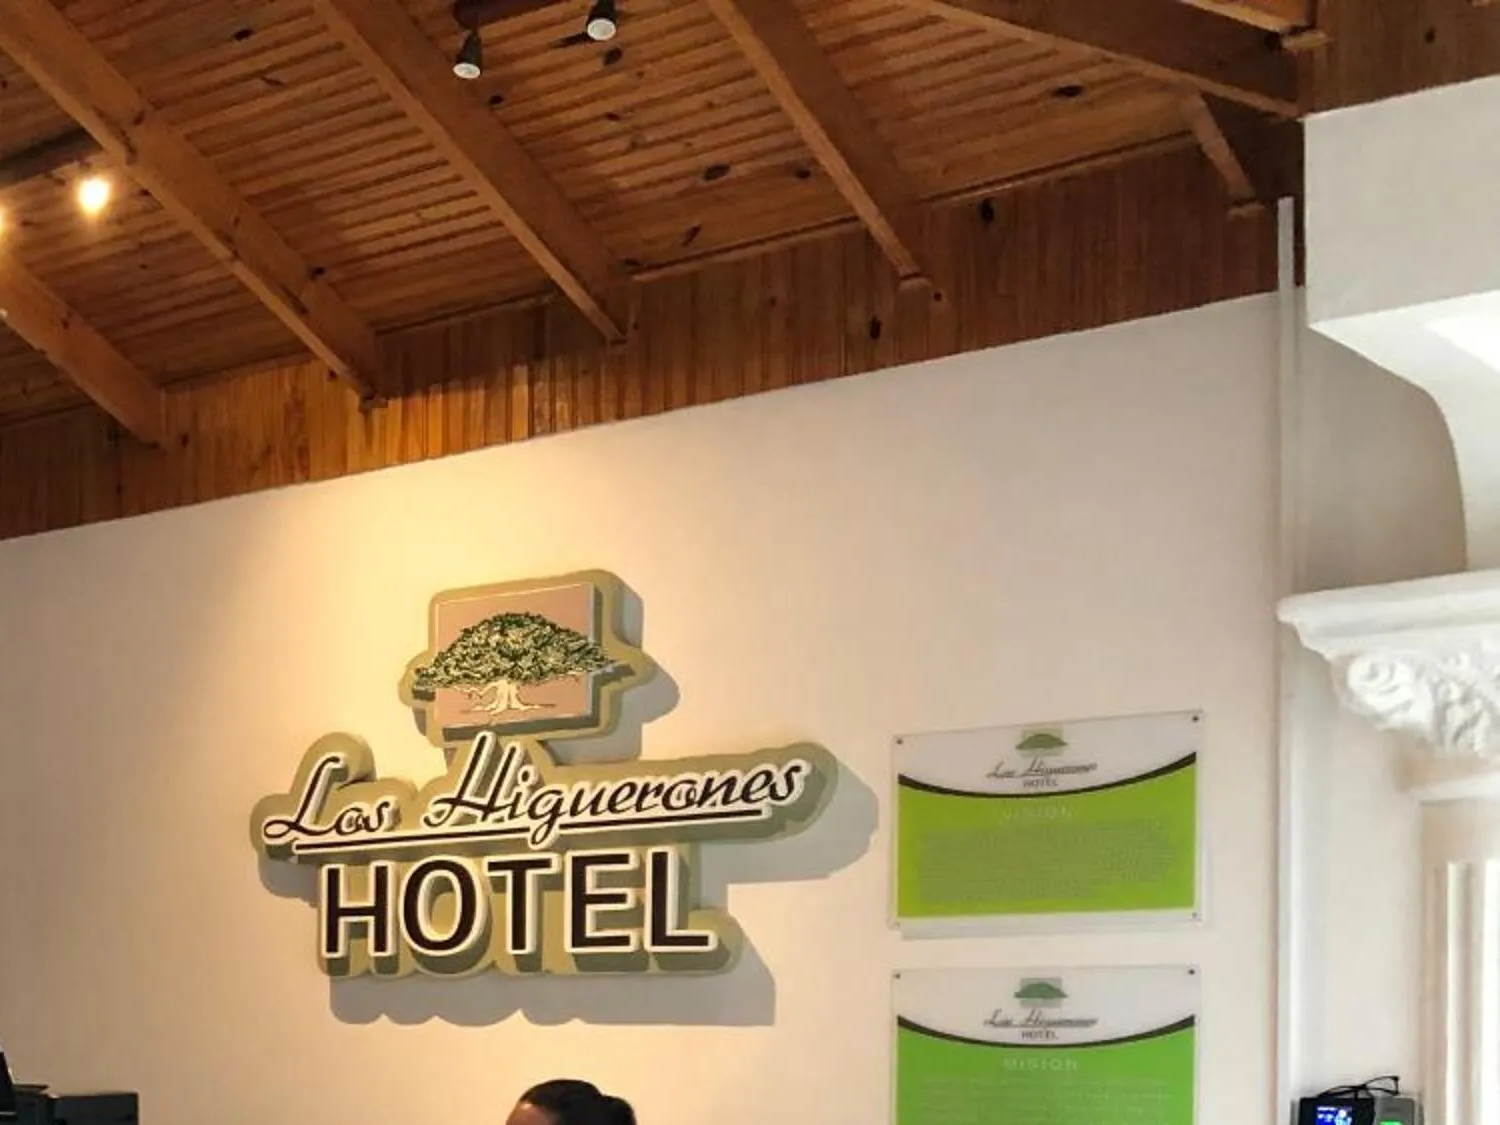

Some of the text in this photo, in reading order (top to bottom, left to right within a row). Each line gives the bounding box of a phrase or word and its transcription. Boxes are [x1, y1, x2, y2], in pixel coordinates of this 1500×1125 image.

[262, 733, 804, 847] Los Higuerones
[324, 849, 711, 956] HOTEL
